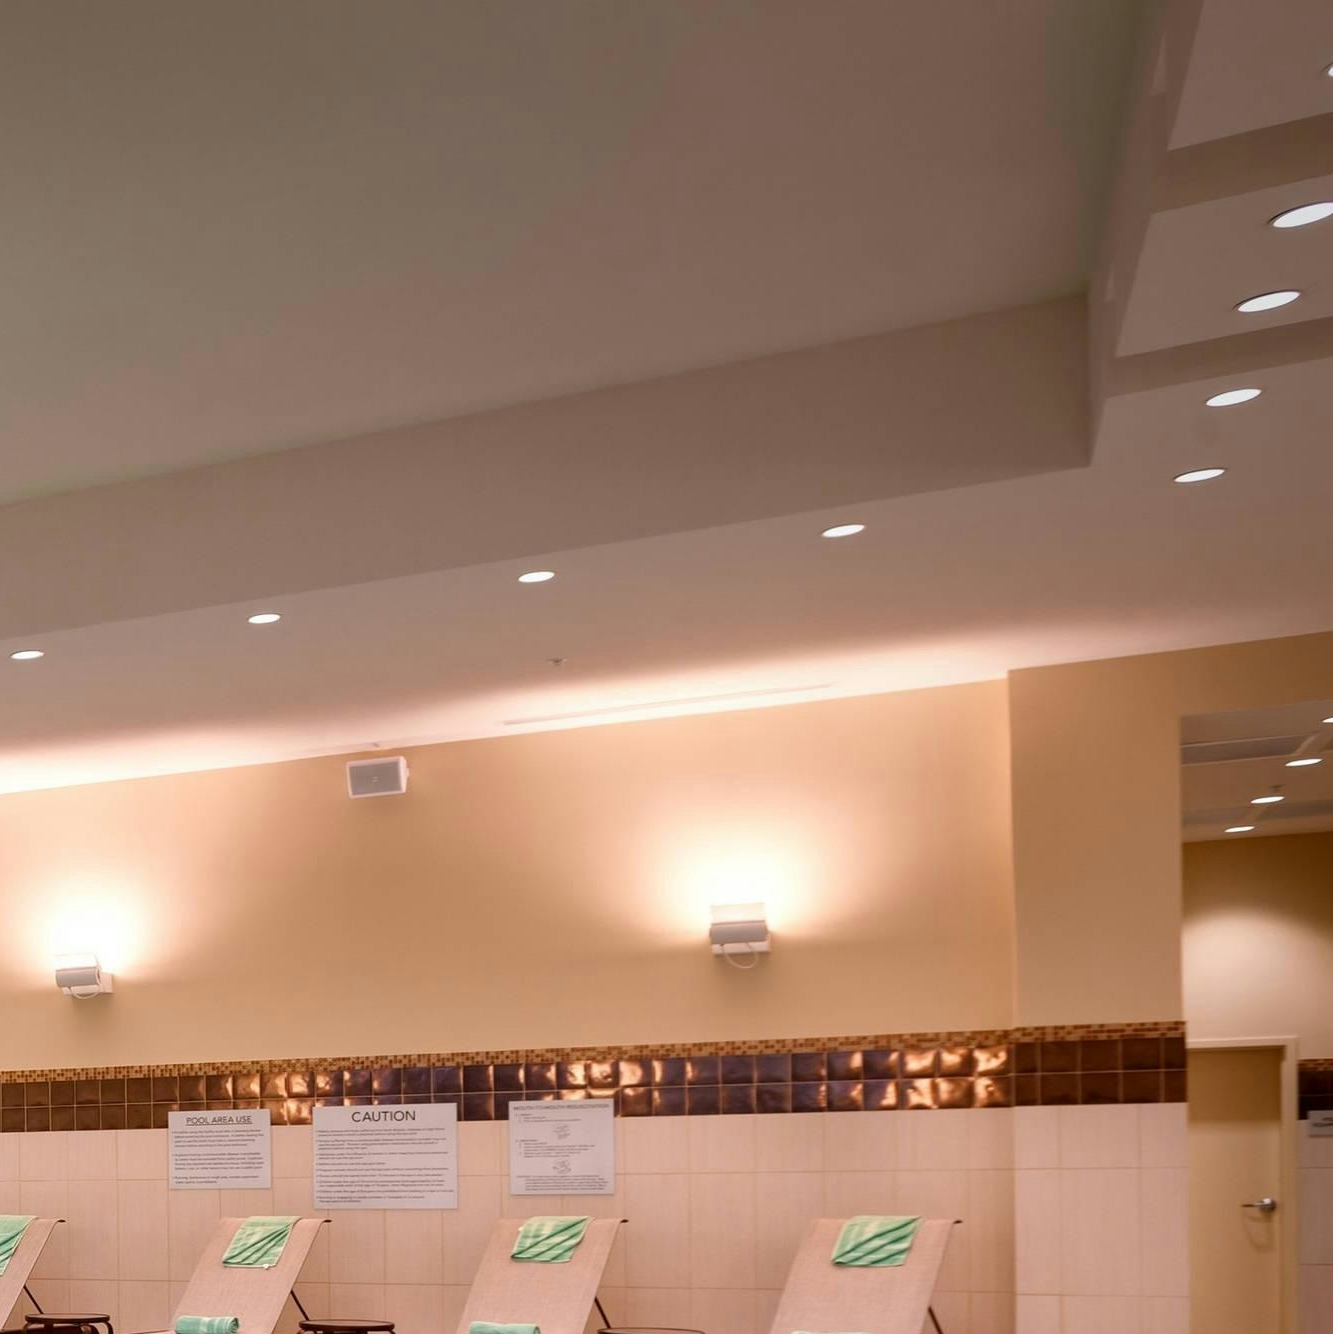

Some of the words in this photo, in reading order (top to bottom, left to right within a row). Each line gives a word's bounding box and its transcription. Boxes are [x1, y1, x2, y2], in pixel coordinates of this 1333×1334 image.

[186, 1117, 209, 1125] POOL
[211, 1116, 234, 1124] AREA
[236, 1115, 252, 1123] USE
[351, 1110, 416, 1122] CAUTION
